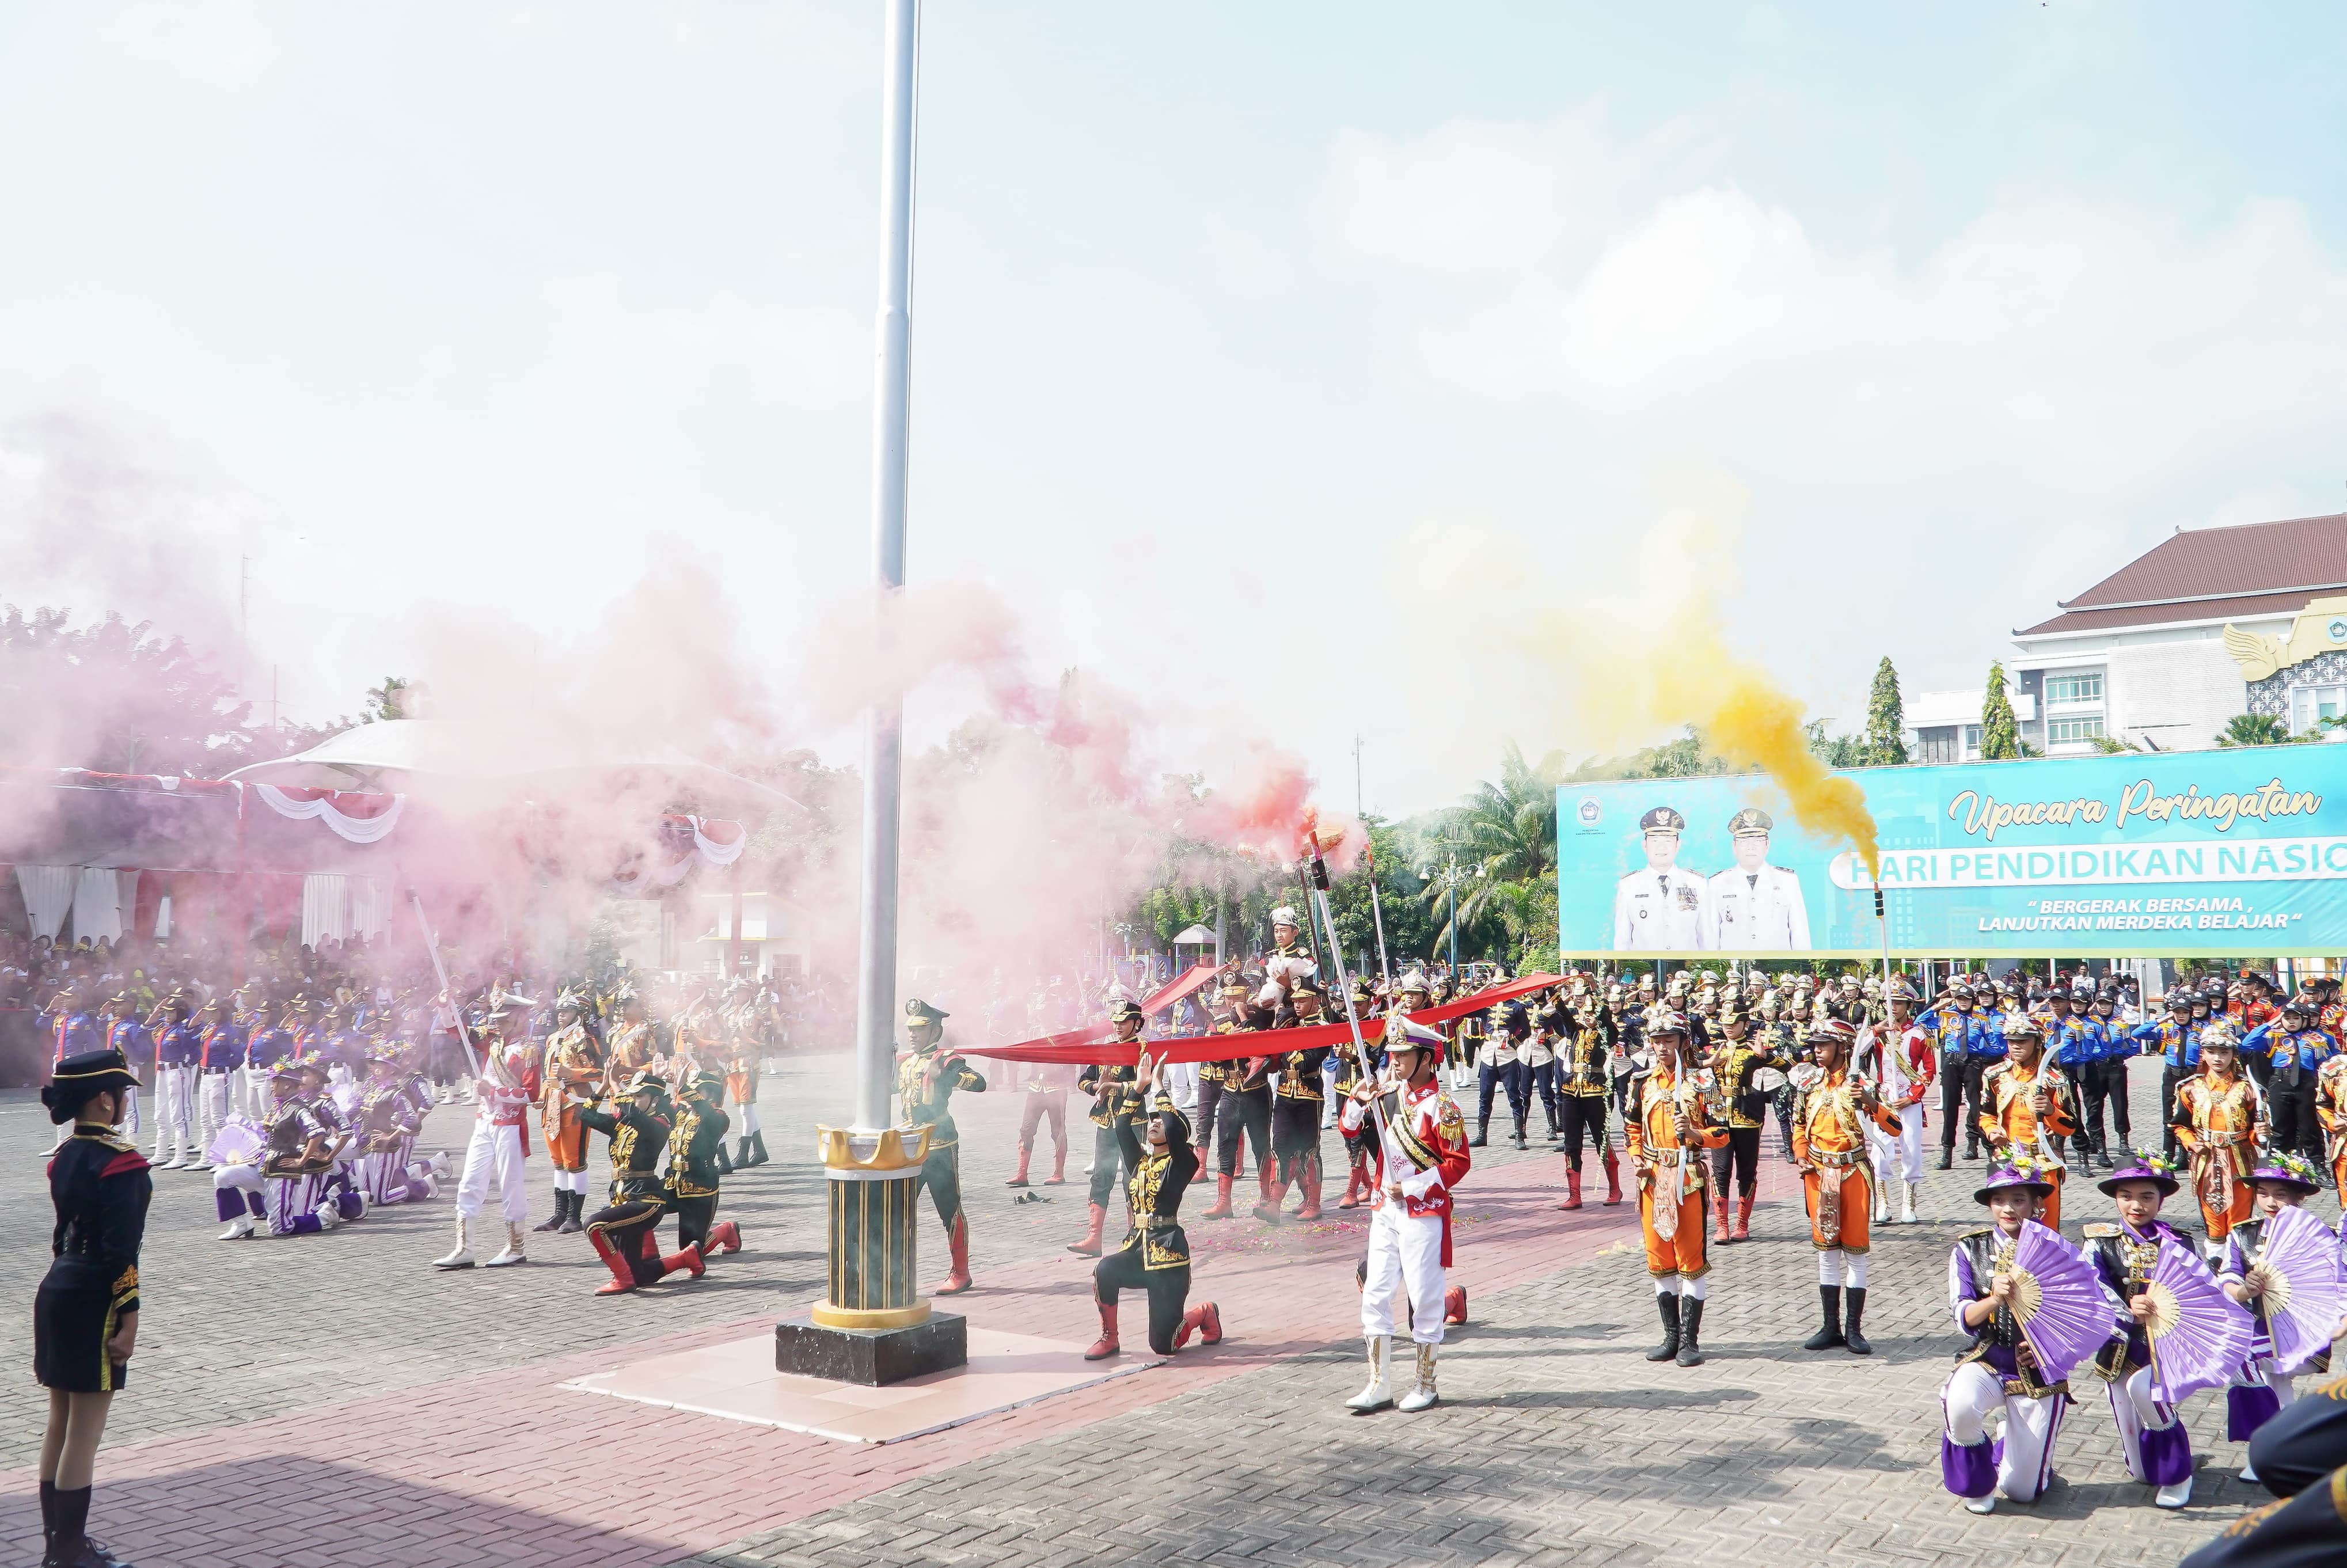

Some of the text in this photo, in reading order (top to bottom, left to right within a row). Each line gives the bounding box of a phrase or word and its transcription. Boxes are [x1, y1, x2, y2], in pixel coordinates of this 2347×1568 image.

[1948, 777, 2322, 841] Upacara Peringatan
[1950, 848, 2202, 880] PENDIDIKAN
[2040, 899, 2144, 914] BERGERAK
[2146, 897, 2243, 913] BERSAMA
[1978, 916, 2092, 931] LANJUTKAN
[2096, 916, 2193, 930] MERDEKA
